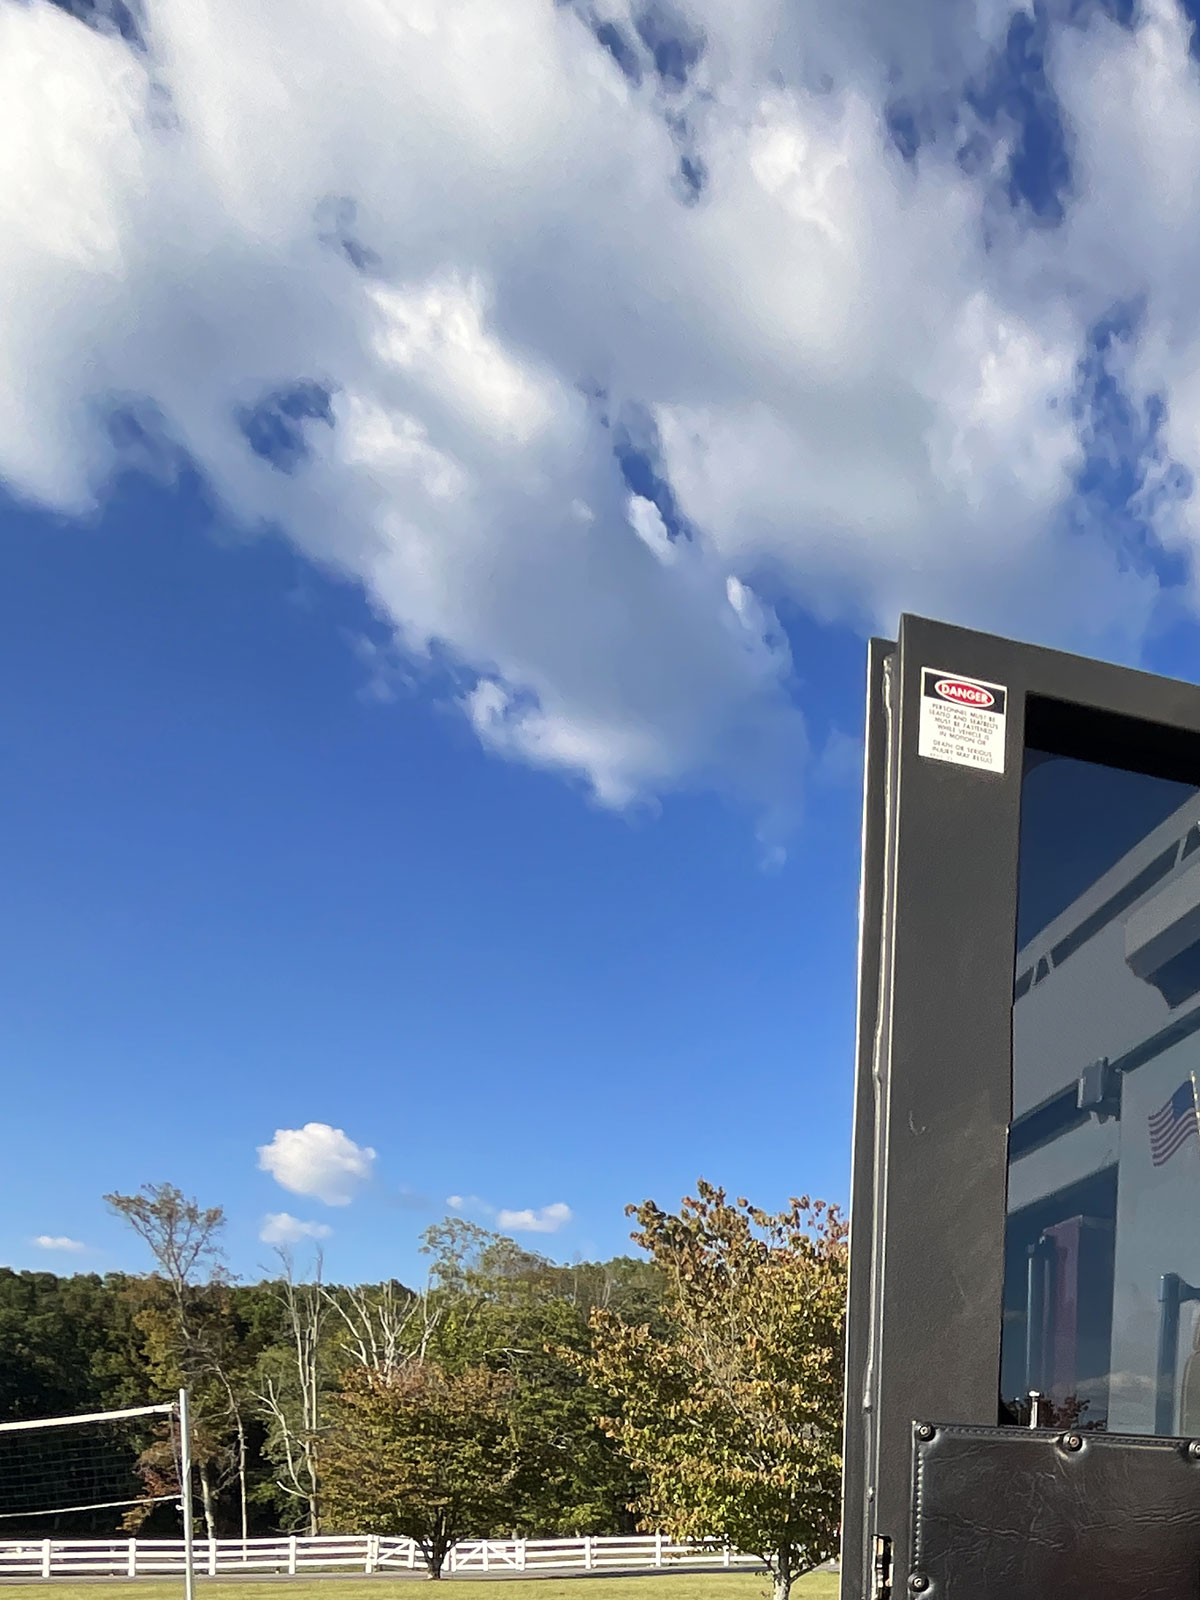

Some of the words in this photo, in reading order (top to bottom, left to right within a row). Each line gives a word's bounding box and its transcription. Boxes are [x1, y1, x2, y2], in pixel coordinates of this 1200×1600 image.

[941, 683, 988, 704] DANGER
[932, 703, 967, 716] PERSONNEL
[929, 709, 950, 719] SEATED
[970, 718, 998, 730] SEATBELTS
[937, 724, 955, 733] WHILE
[959, 729, 981, 738] VEHICLE
[963, 723, 993, 735] FASTENED
[949, 733, 975, 743] MOTION
[932, 746, 953, 755] INJURY
[972, 755, 992, 764] RESULT
[933, 739, 953, 748] DEATH
[967, 747, 992, 757] SERIOUS
